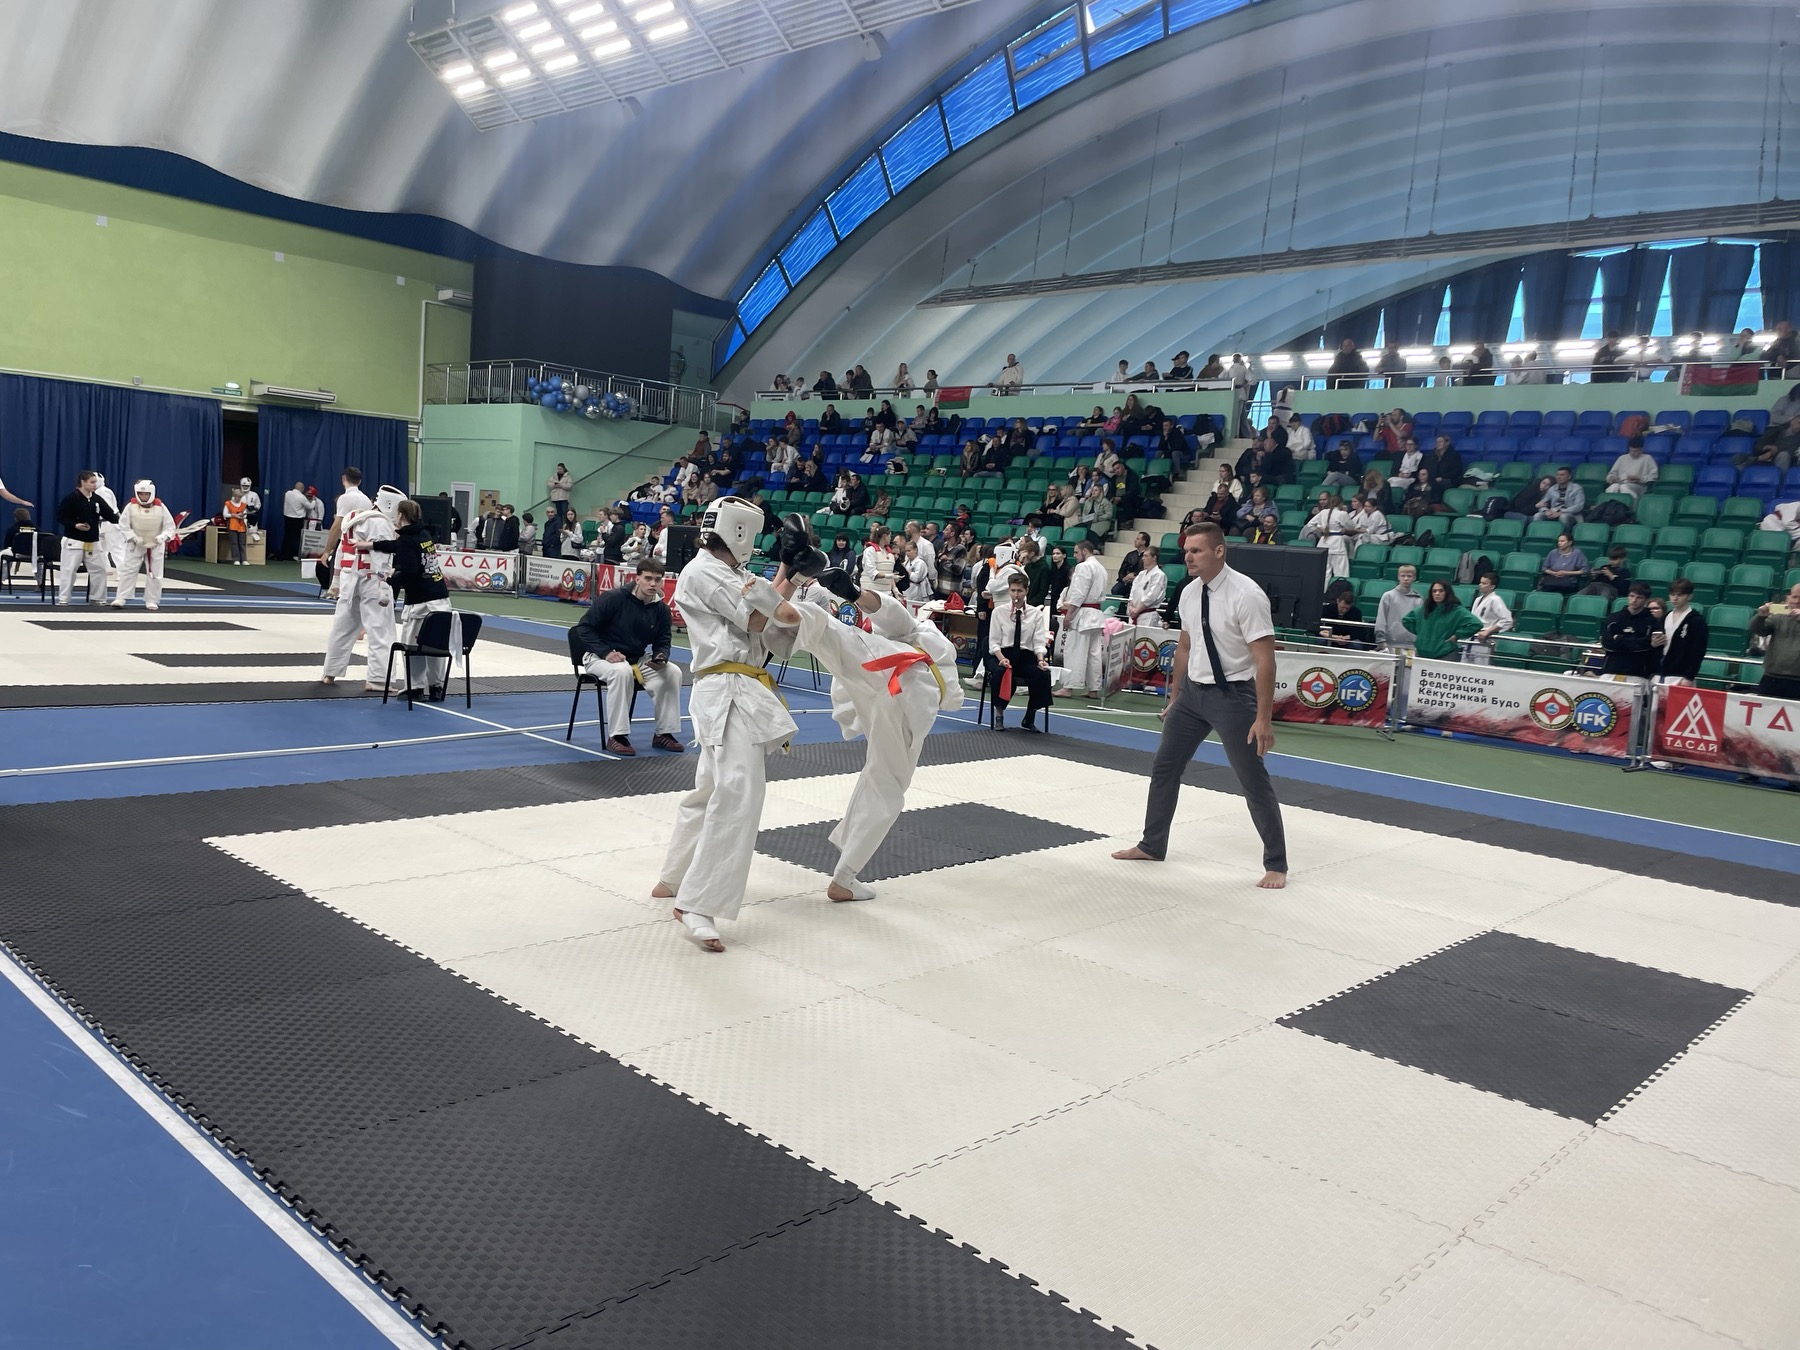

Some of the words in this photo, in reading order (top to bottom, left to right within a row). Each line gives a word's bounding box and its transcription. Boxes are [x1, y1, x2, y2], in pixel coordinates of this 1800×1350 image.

[841, 614, 855, 624] IFK
[1420, 669, 1495, 686] Белорусская
[1419, 678, 1484, 694] федерация
[1340, 688, 1369, 702] IFK
[1417, 697, 1456, 709] каратэ
[1491, 697, 1520, 709] Будо
[1576, 712, 1608, 728] IFK
